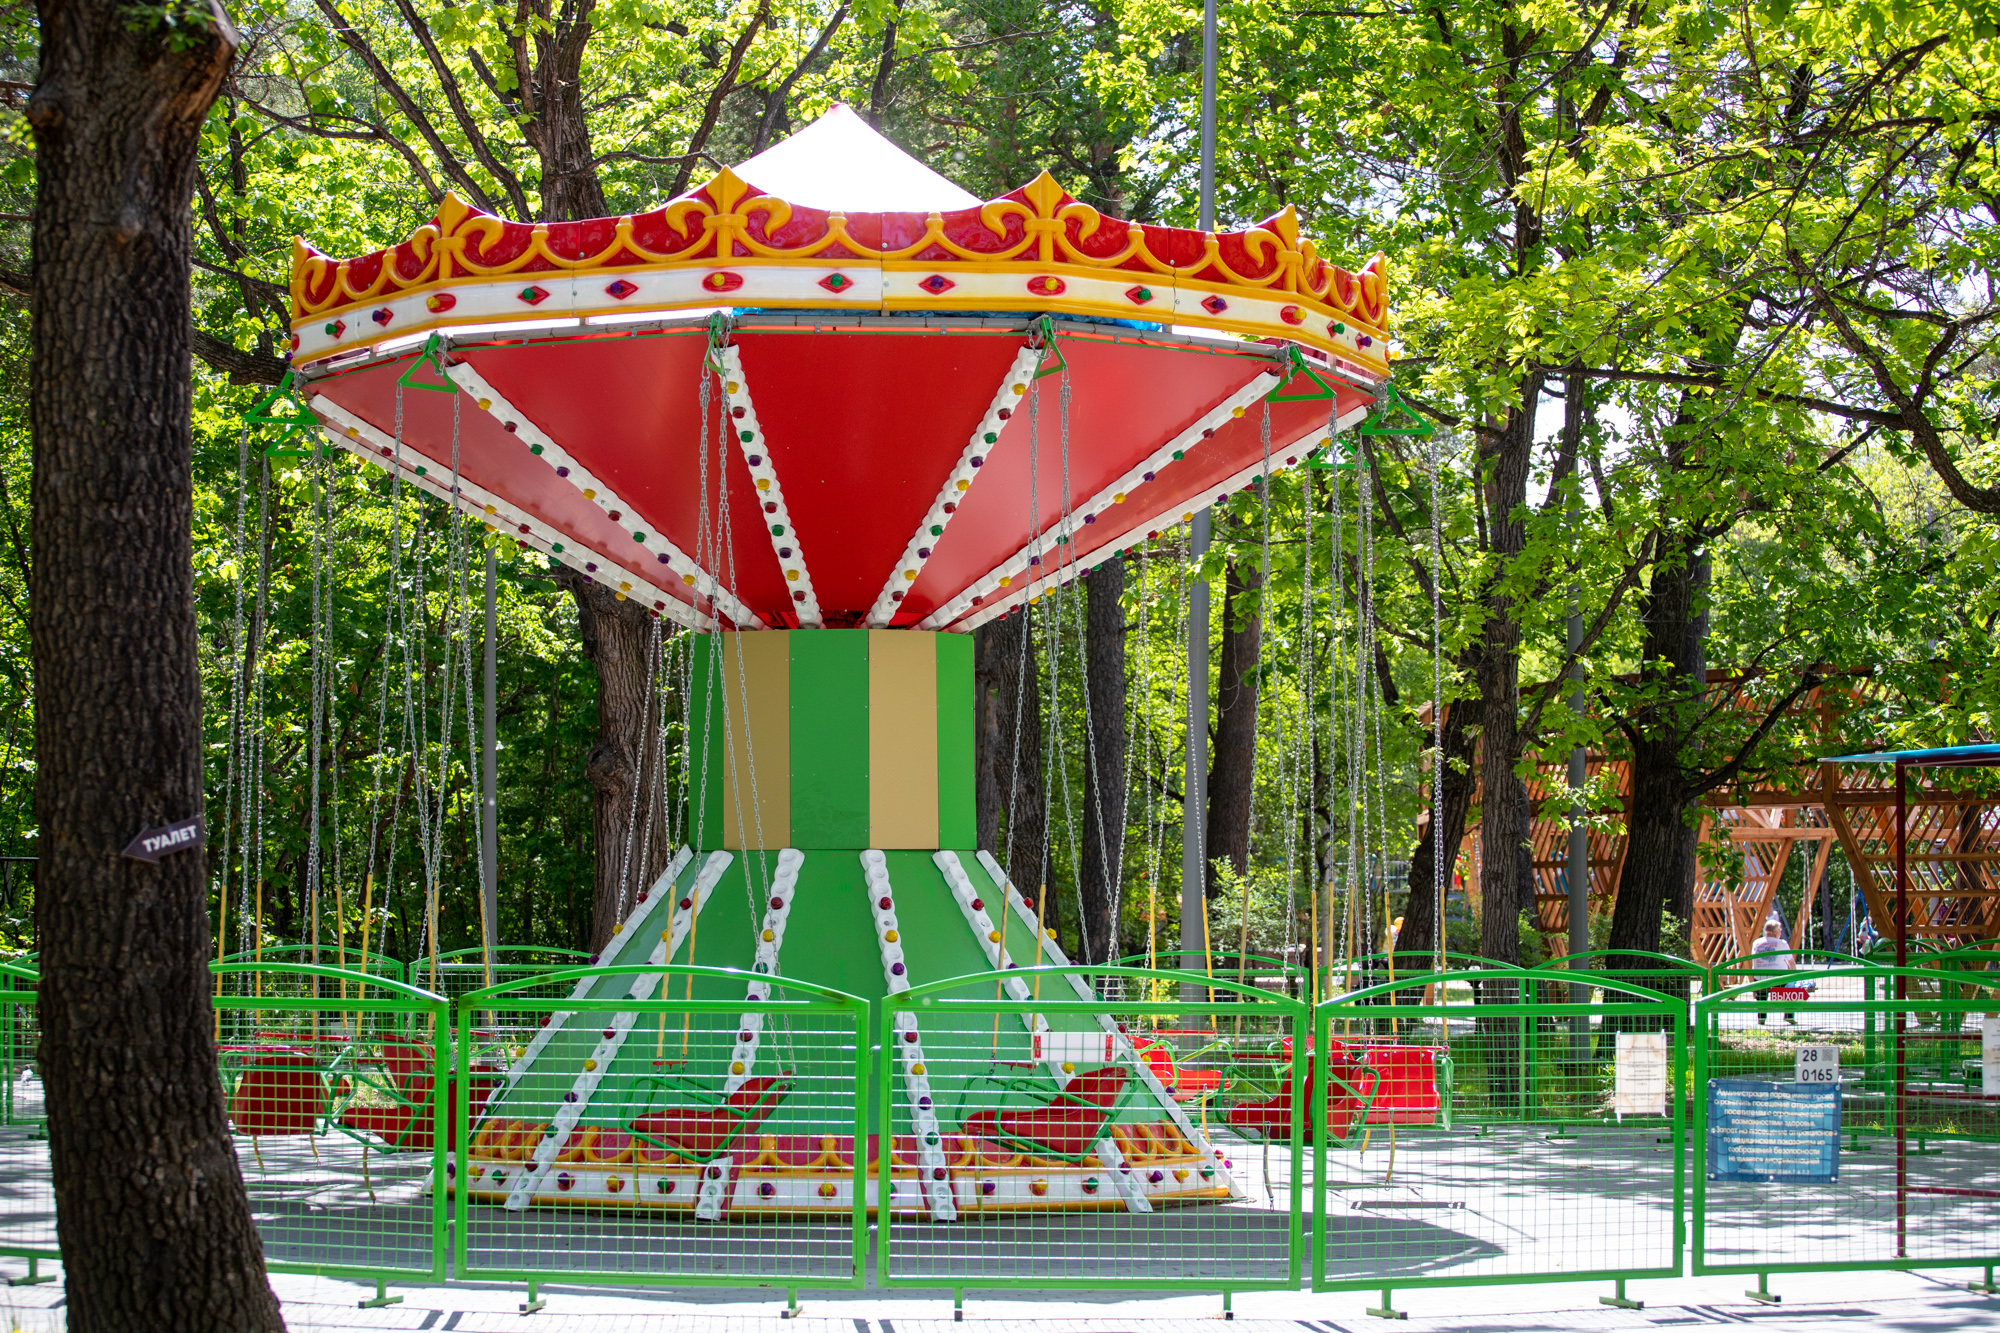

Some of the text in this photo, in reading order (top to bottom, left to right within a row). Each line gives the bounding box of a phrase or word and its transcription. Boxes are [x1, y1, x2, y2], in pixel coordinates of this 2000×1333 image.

[142, 824, 197, 853] ТУАЛЕТ
[1771, 991, 1804, 1001] ВЫХОД
[1802, 1049, 1818, 1062] 28
[1802, 1068, 1833, 1081] 0165
